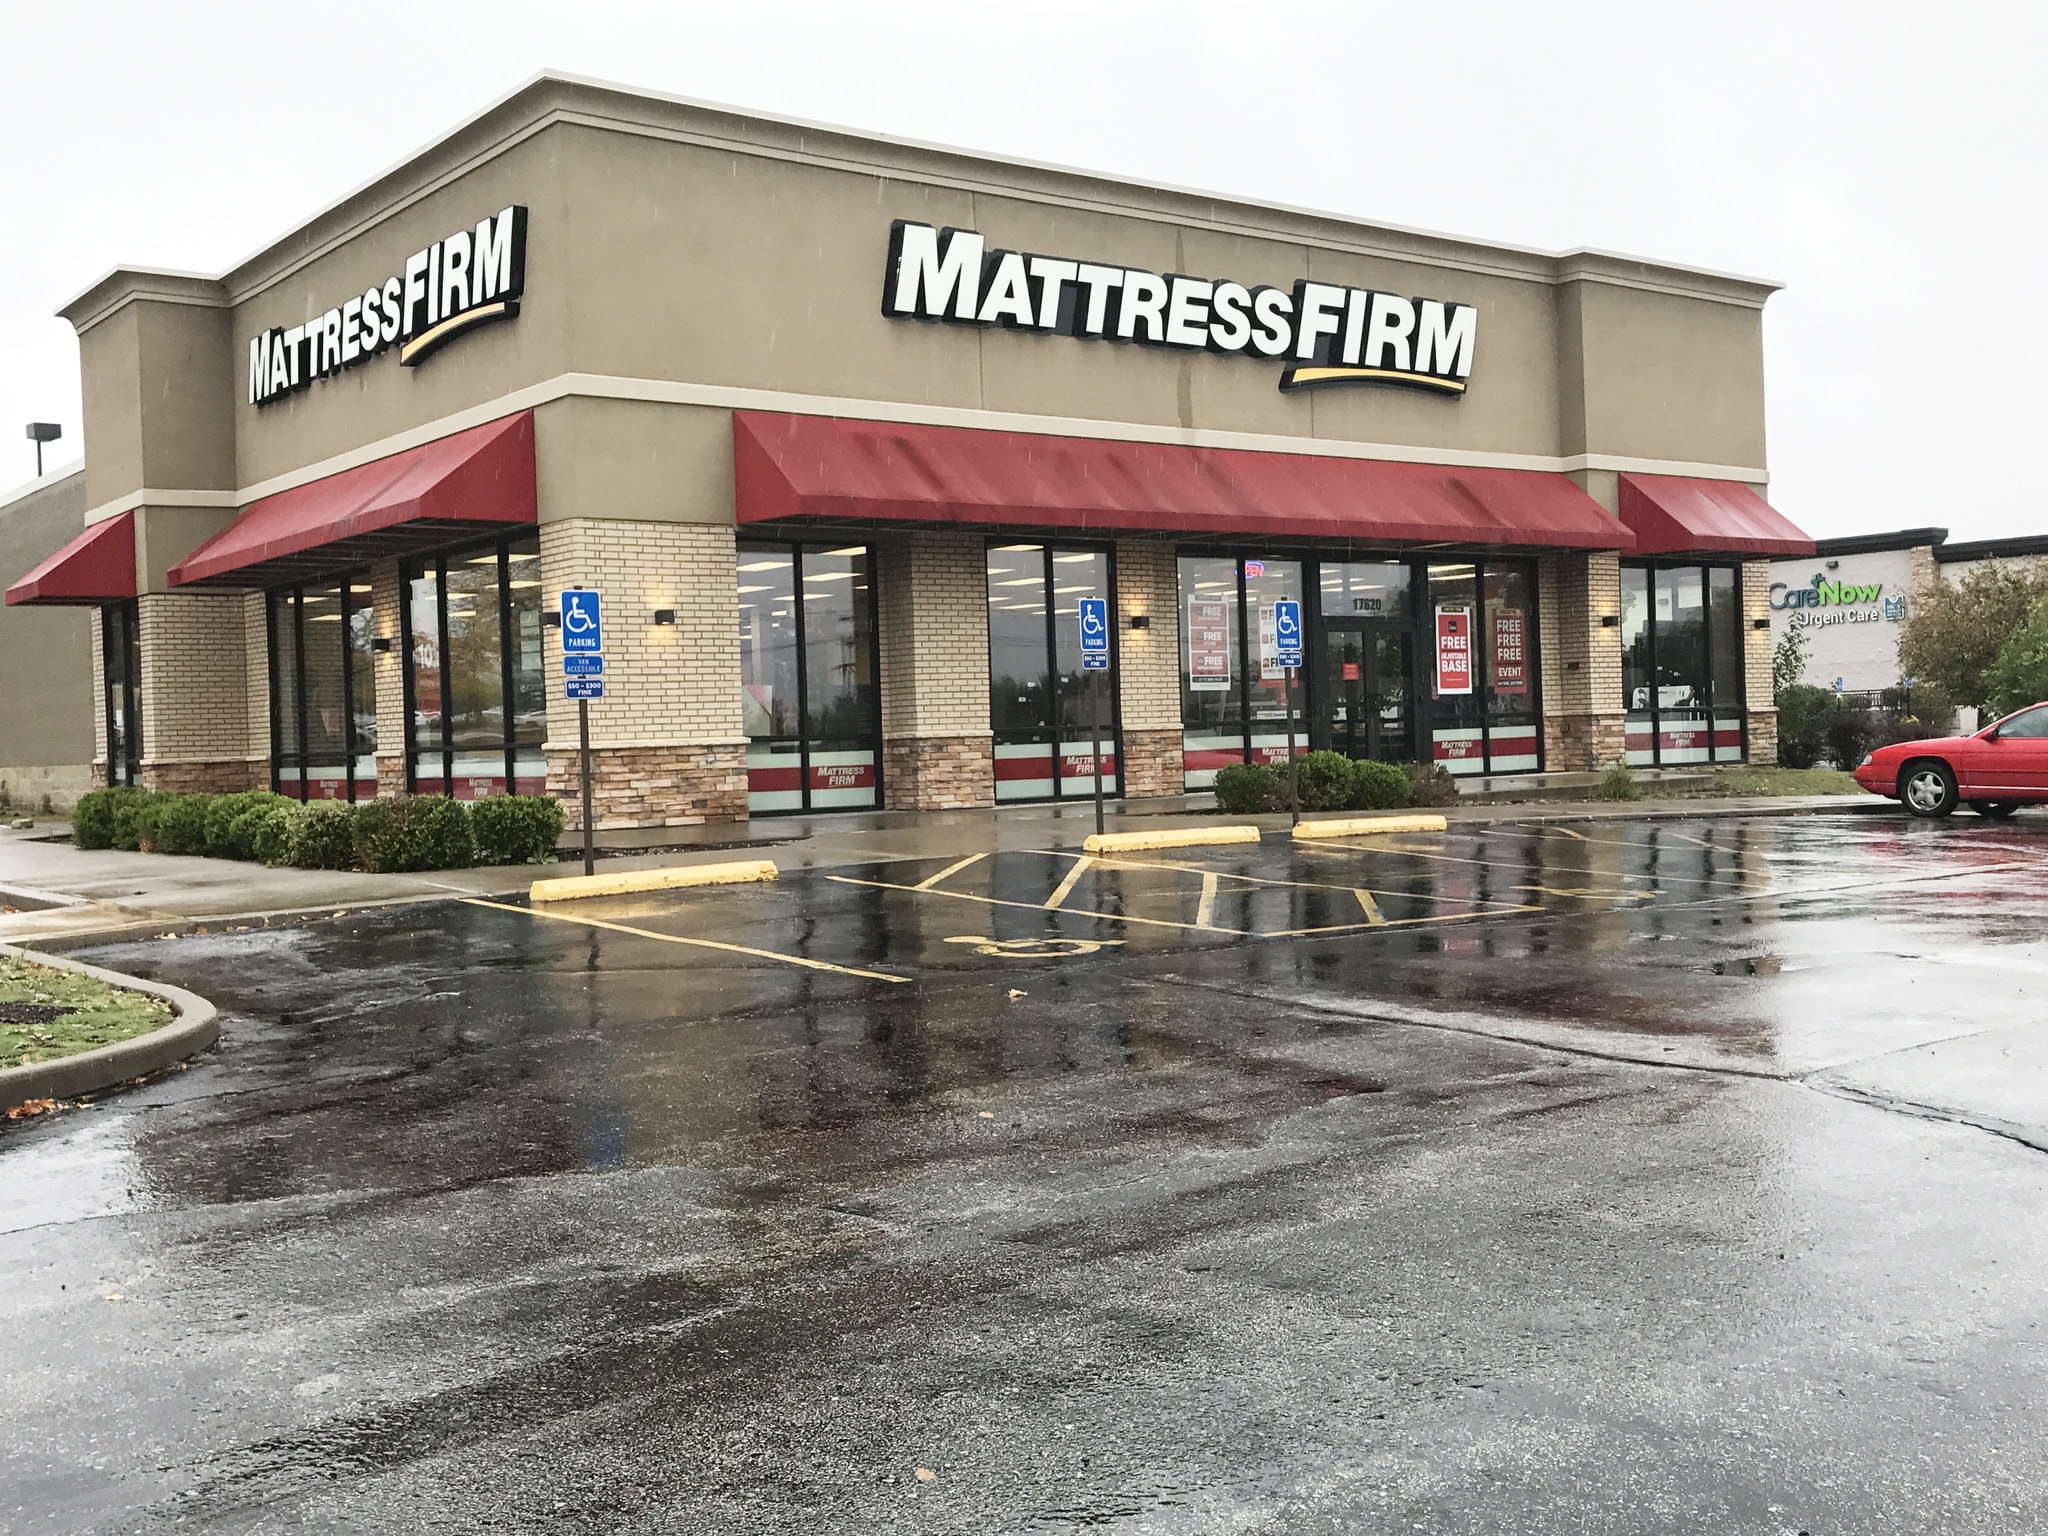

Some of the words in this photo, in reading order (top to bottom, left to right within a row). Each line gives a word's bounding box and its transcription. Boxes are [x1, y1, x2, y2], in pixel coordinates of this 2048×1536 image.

[1245, 564, 1263, 577] PEN
[1770, 580, 1881, 610] CareNow
[1353, 598, 1381, 610] 17620
[1203, 607, 1221, 616] FREE
[1800, 611, 1846, 627] Urgent
[1847, 609, 1878, 623] Care
[1497, 620, 1520, 632] FREE
[1203, 631, 1222, 641] FREE
[1280, 637, 1298, 645] PARKING
[1497, 634, 1521, 646] FREE
[569, 638, 596, 647] PARKING
[1085, 638, 1104, 646] PARKING
[1441, 636, 1466, 649] FREE
[1498, 648, 1521, 660] FREE
[1204, 656, 1223, 666] FREE
[1442, 660, 1467, 672] BASE
[567, 665, 601, 673] ACCESSIBLE
[1498, 667, 1521, 676] EVENT
[1441, 741, 1472, 749] MATTRESS
[1262, 748, 1289, 756] MATTRE
[1448, 748, 1466, 756] FIRM
[1066, 756, 1107, 765] MATTRSS
[818, 767, 864, 776] MATTRESS
[828, 775, 856, 785] FIRM
